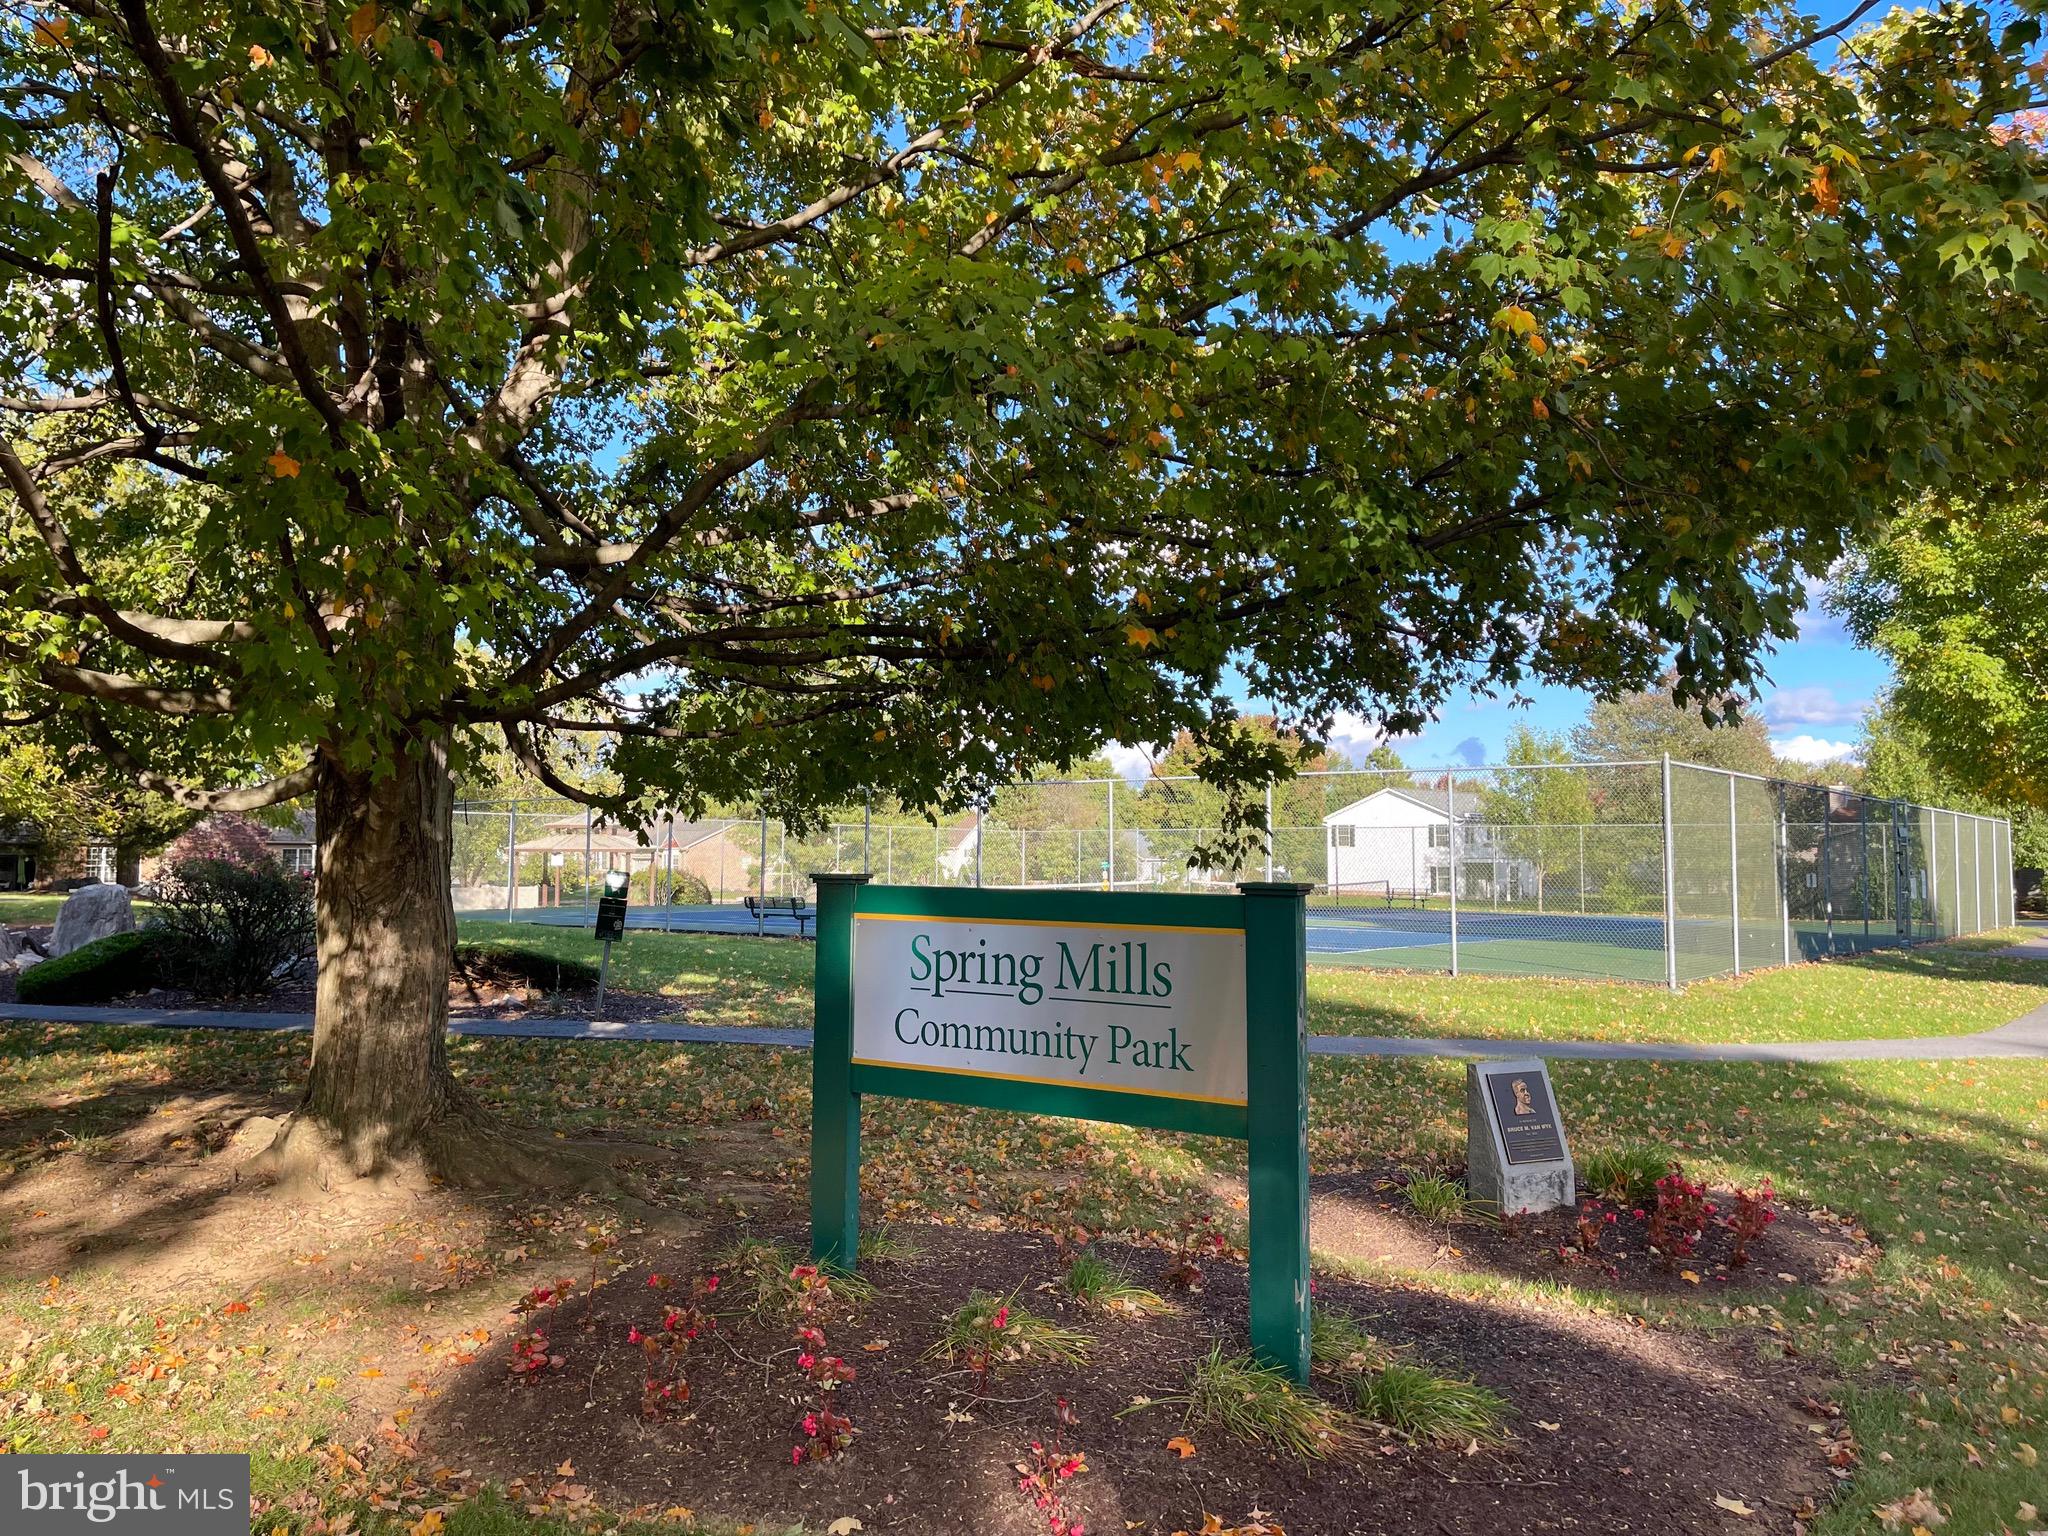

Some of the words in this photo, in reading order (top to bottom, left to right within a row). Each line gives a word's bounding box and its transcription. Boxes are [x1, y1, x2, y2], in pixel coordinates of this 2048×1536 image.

[910, 934, 1045, 1006] Spring
[1053, 941, 1173, 998] Mills
[894, 1007, 1099, 1075] Community
[1106, 1024, 1196, 1073] Park
